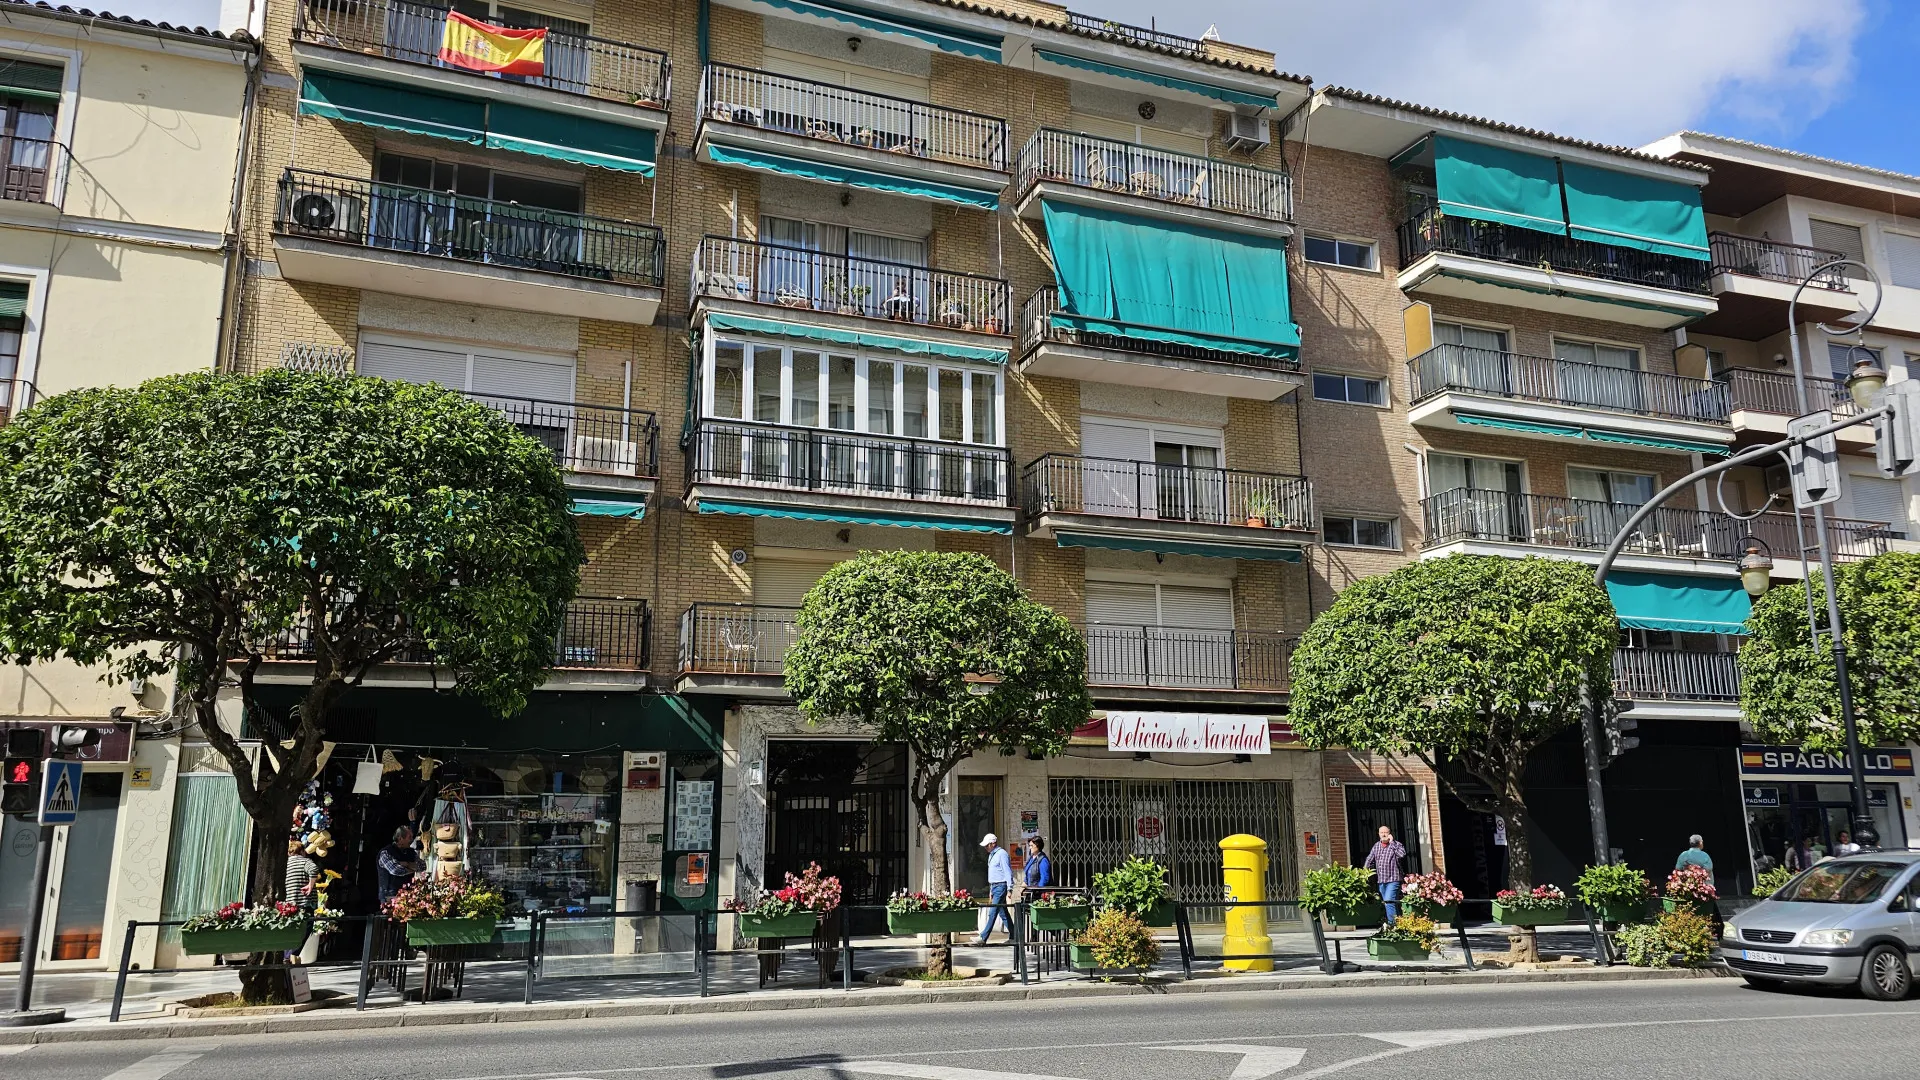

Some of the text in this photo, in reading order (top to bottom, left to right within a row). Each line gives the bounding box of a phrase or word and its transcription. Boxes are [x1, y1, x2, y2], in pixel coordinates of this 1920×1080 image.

[1110, 715, 1266, 751] Delicias de Navidad
